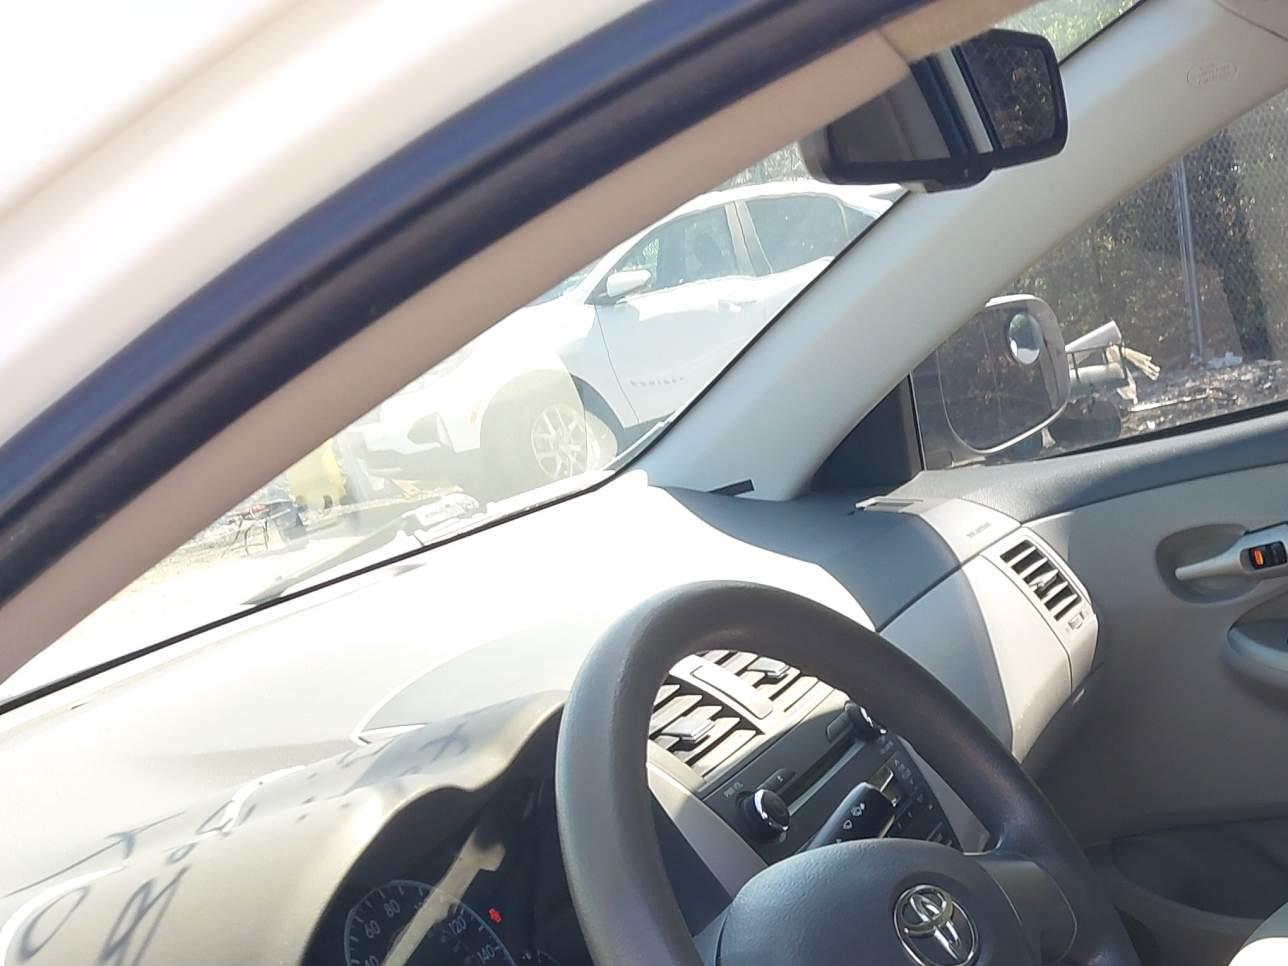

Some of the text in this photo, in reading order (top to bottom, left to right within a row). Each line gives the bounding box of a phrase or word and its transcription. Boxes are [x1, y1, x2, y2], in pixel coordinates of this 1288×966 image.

[383, 899, 401, 918] 80
[363, 919, 381, 938] 60
[448, 916, 467, 935] 120
[476, 943, 496, 965] 140
